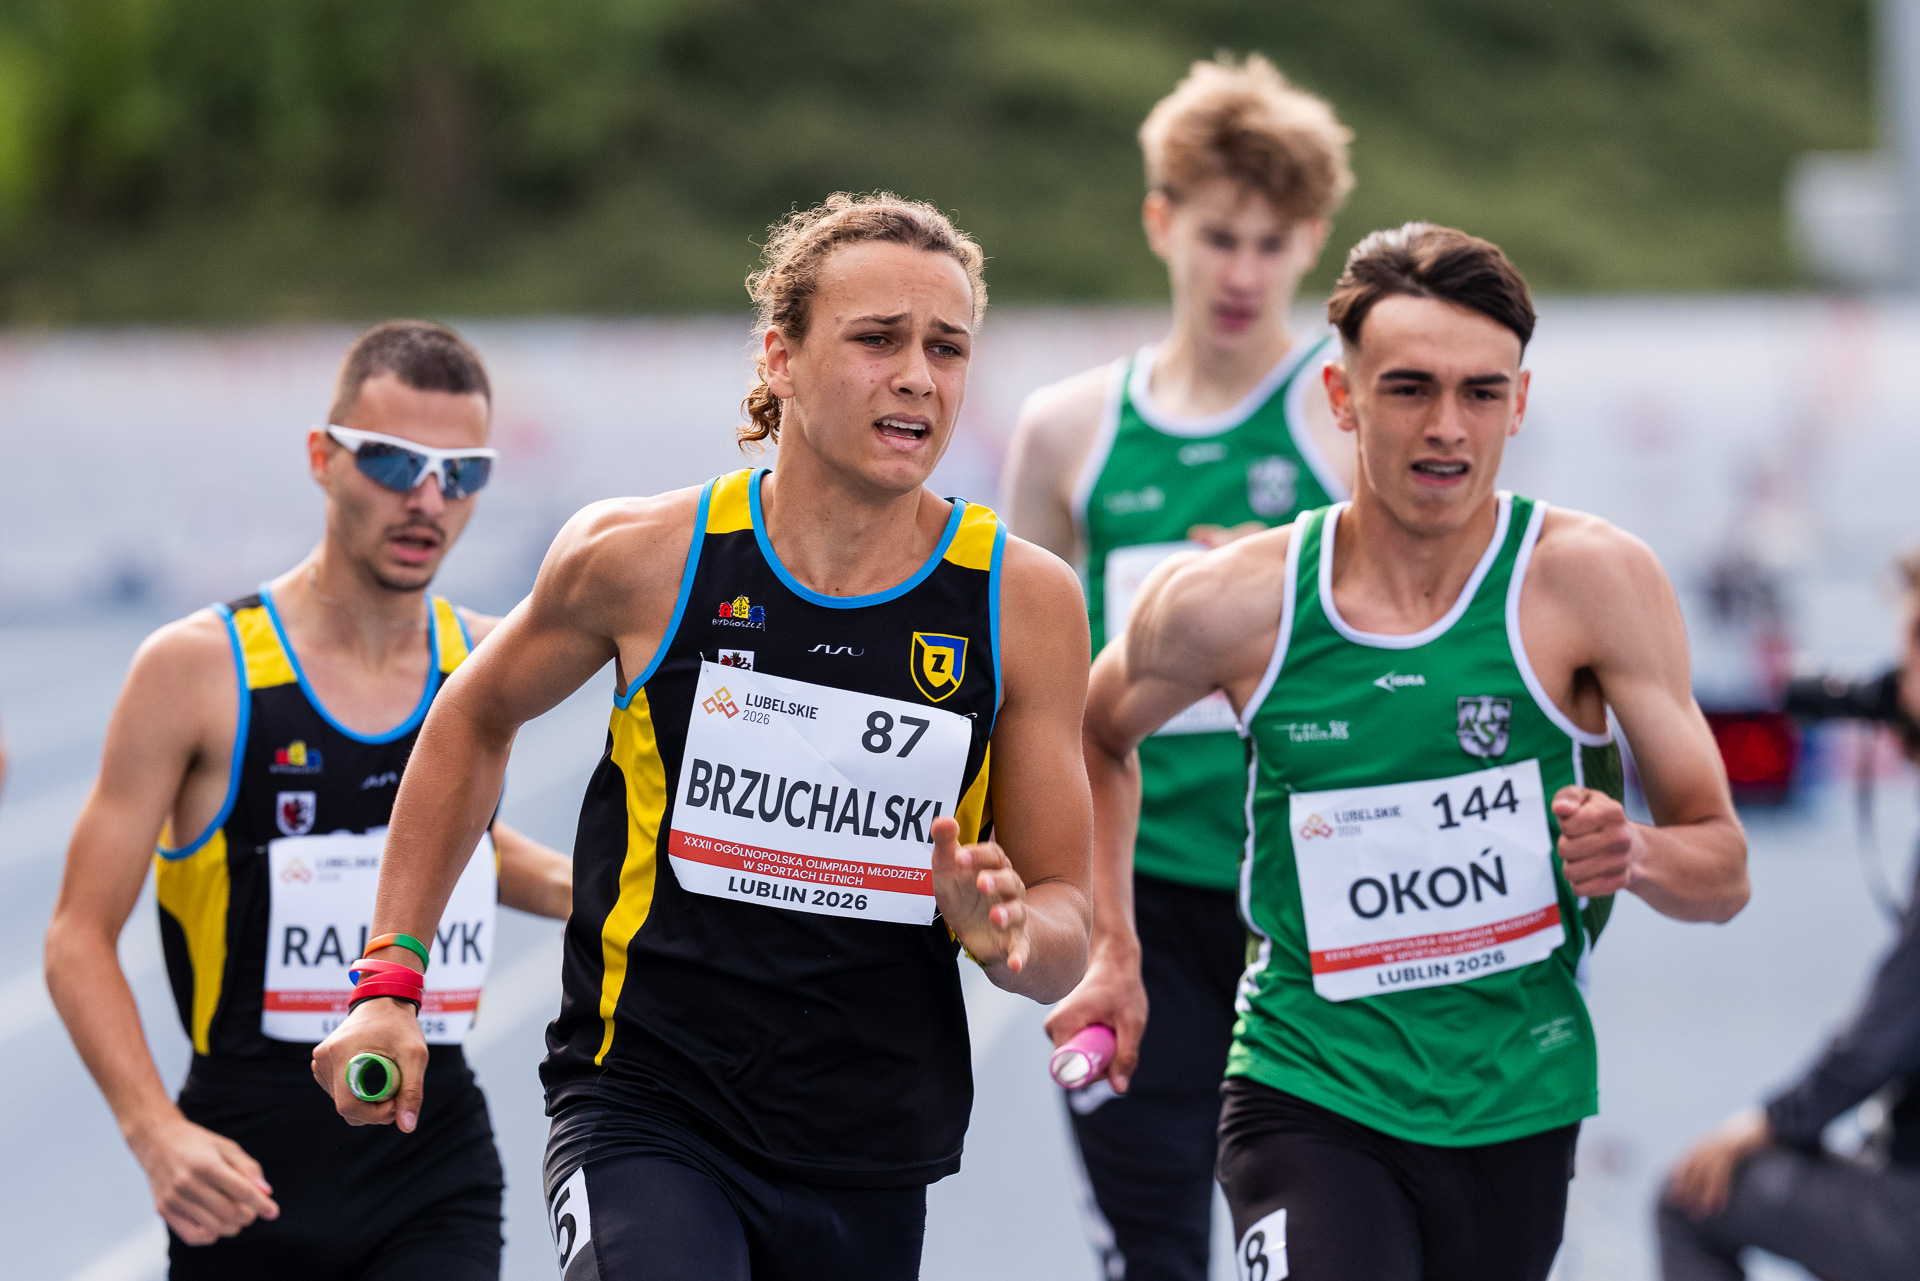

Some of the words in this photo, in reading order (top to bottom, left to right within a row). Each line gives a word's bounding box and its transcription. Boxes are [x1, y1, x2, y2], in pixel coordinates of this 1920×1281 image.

[712, 618, 765, 632] BYDGOSZCZ
[931, 653, 947, 674] Z
[743, 710, 770, 725] 2026
[745, 693, 819, 720] LUBELSKIE
[861, 710, 930, 759] 87
[685, 758, 943, 845] BRZUCHALSKI
[1334, 805, 1401, 824] LUBELSKIE
[1432, 779, 1519, 830] 144
[683, 835, 712, 851] XXXII
[714, 841, 804, 867] OGÓLNOPOLSKA
[806, 859, 865, 875] OLIMPIADA
[867, 864, 927, 882] MŁODZIEŻY
[742, 859, 755, 870] W
[756, 862, 817, 880] SPORTACH
[818, 873, 864, 886] LETNICH
[728, 876, 807, 904] LUBLIN
[811, 889, 868, 911] 2026
[1349, 846, 1508, 920] OKOŃ
[282, 921, 484, 967] RAJYK
[1377, 962, 1450, 986] LUBLIN
[1455, 950, 1506, 975] 2026
[554, 1186, 577, 1269] 5
[1245, 1230, 1269, 1281] 8
